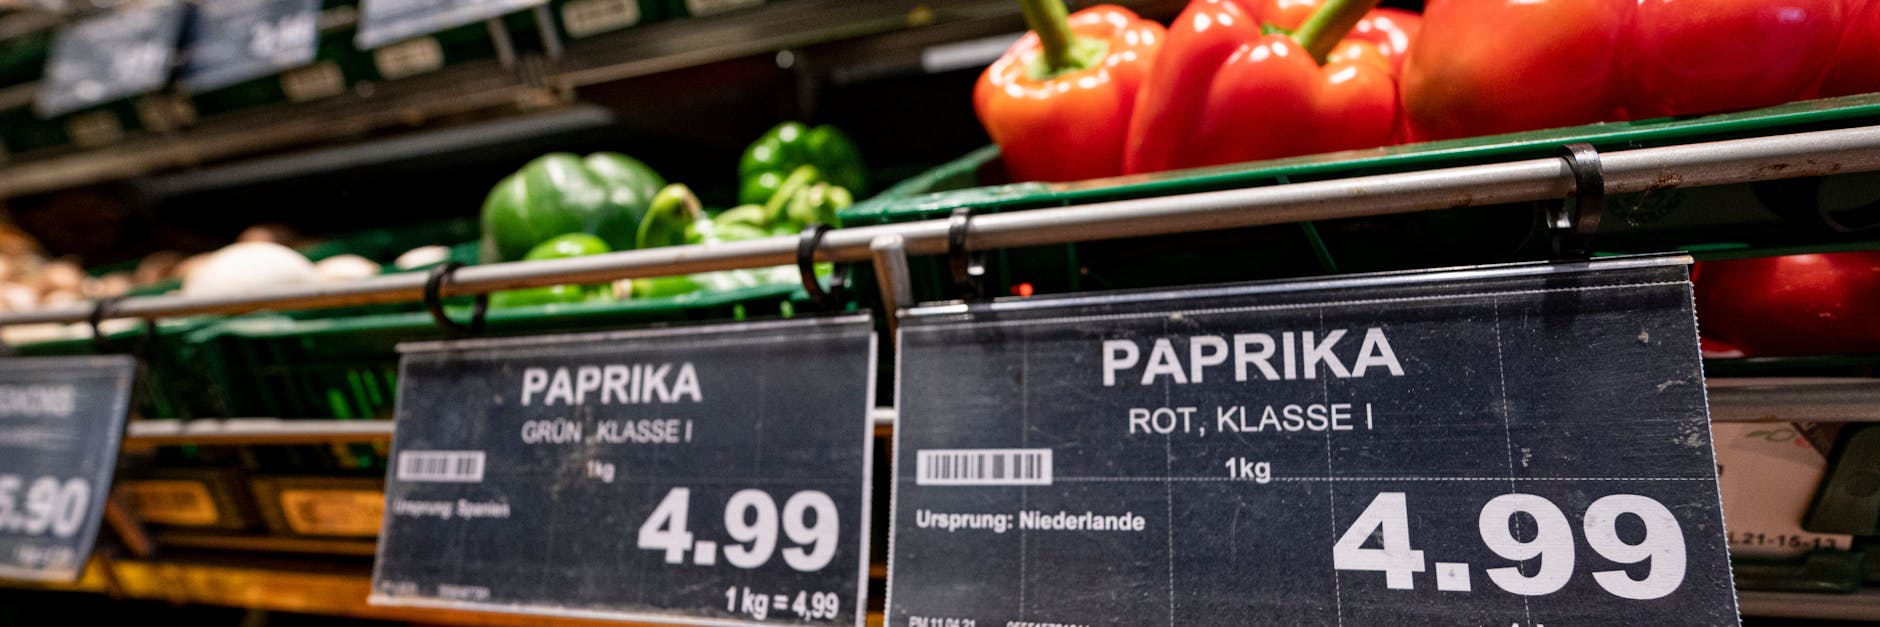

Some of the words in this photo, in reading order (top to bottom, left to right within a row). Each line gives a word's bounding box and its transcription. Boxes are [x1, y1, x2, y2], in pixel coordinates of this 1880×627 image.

[1102, 327, 1405, 386] PAPRIKA
[520, 362, 703, 406] PAPRIKA
[593, 419, 681, 444] KLASSE
[684, 420, 693, 443] I
[1129, 407, 1205, 437] ROT,
[1217, 403, 1354, 434] KLASSE
[1366, 402, 1374, 430] I
[586, 459, 616, 483] 1kg
[1225, 457, 1272, 484] 1kg
[637, 487, 840, 572] 4.99
[915, 508, 1014, 534] Ursprung:
[1018, 509, 1146, 532] Niederlande
[1332, 491, 1687, 600] 4.99
[725, 585, 737, 612] 1
[740, 586, 770, 622] kg
[772, 594, 790, 610] =
[791, 590, 840, 622] 4,99
